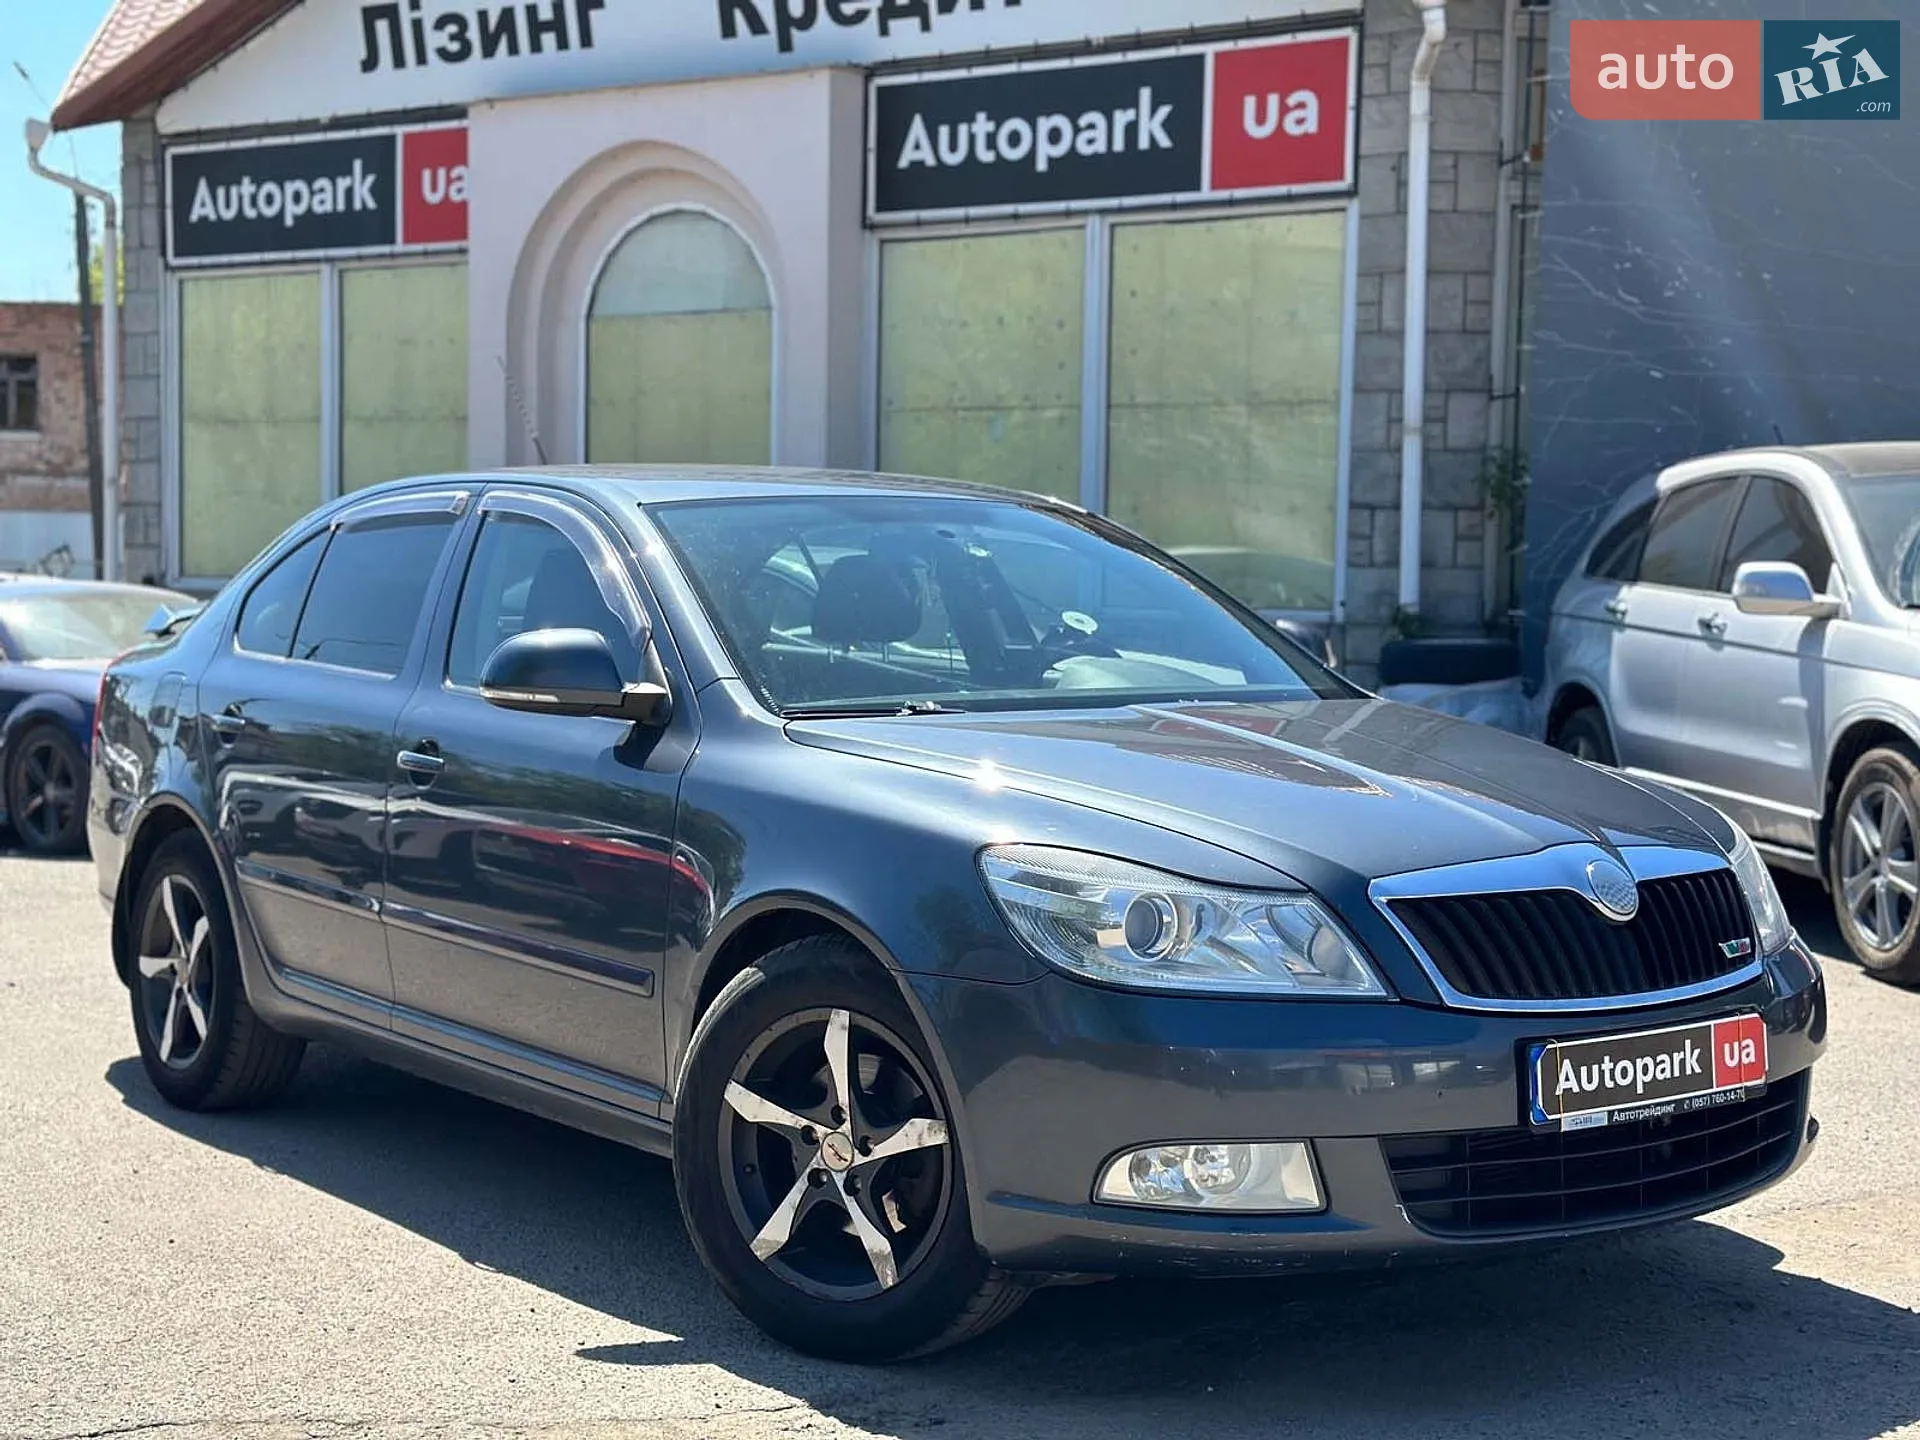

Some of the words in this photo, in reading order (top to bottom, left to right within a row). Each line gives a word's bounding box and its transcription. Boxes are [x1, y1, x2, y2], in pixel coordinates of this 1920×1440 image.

[360, 0, 605, 74] Лізинг
[717, 0, 1022, 53] Кред
[897, 86, 1174, 173] Autopark
[1242, 88, 1320, 140] ua
[188, 158, 378, 227] Autopark
[421, 164, 469, 205] ua
[1555, 1039, 1702, 1096] Autopark
[1723, 1037, 1756, 1068] ua
[1612, 1103, 1676, 1122] Автотрейдинг
